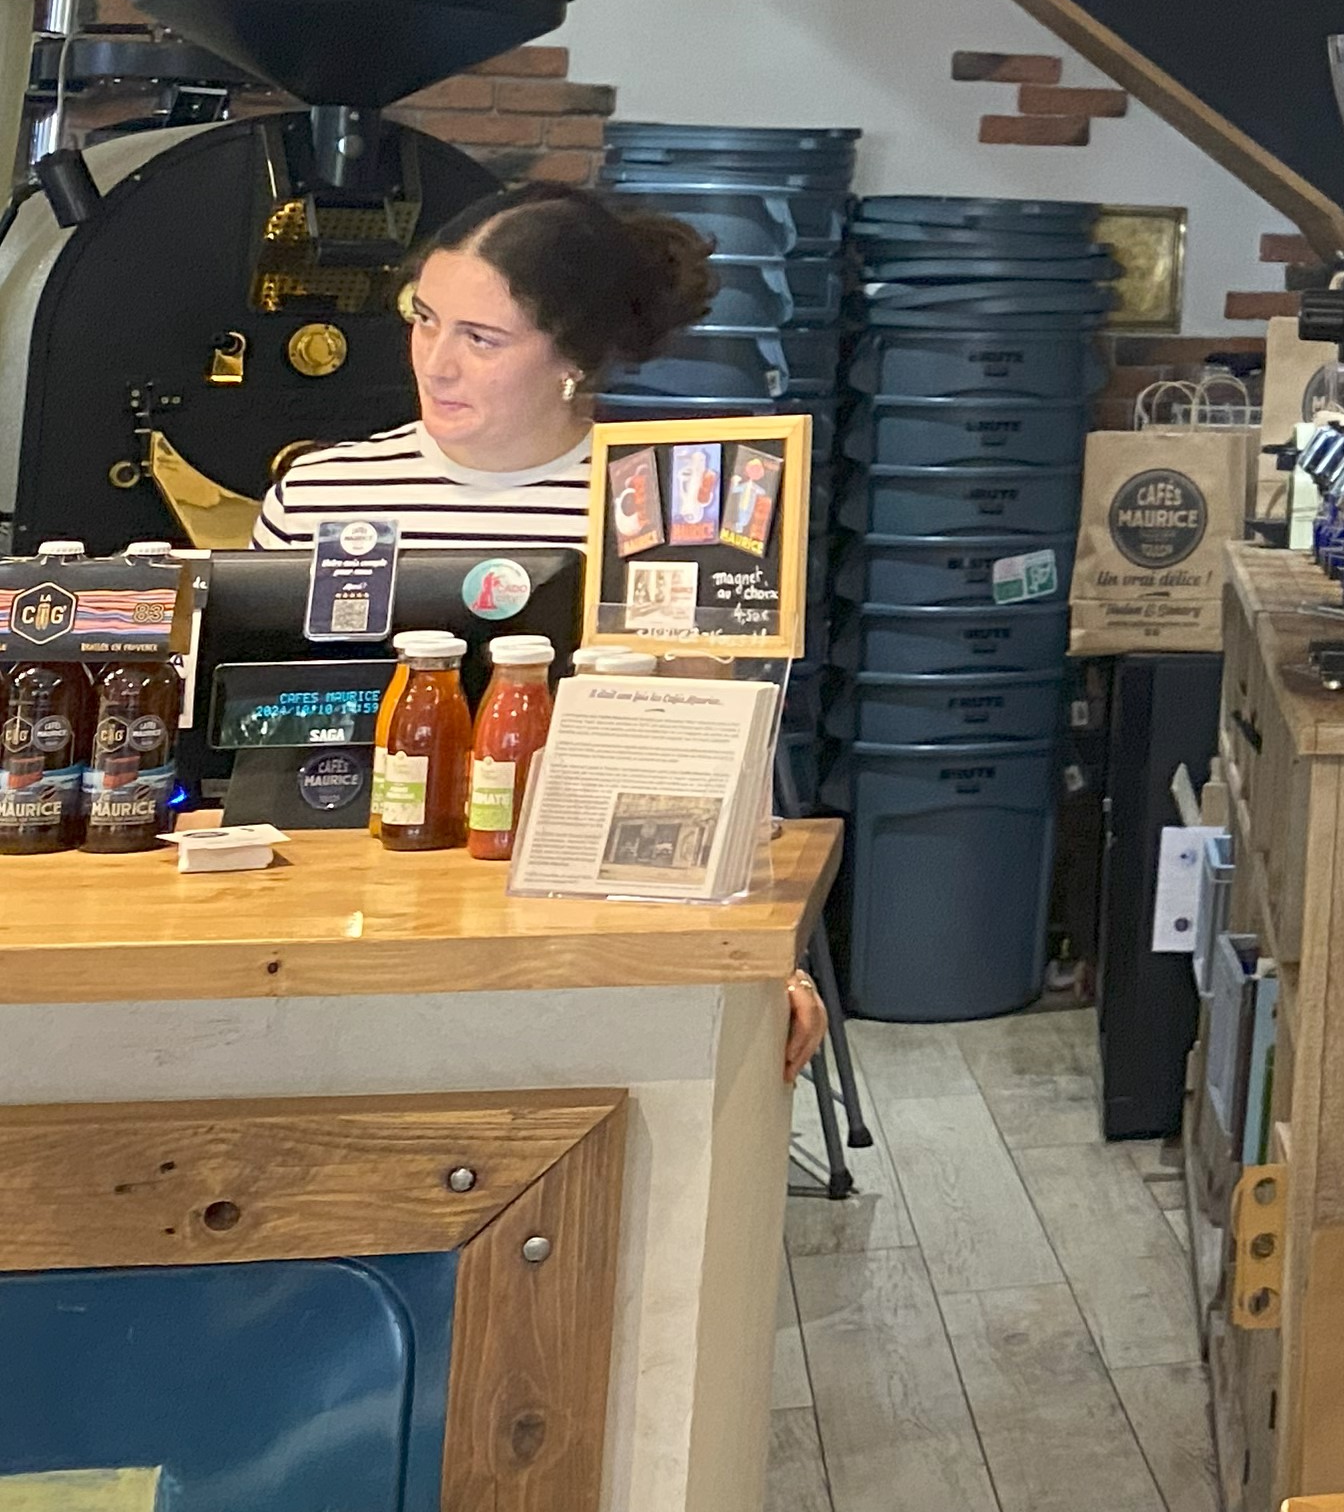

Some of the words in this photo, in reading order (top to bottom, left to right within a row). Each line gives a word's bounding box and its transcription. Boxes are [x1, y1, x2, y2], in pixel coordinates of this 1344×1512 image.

[1136, 480, 1183, 507] CAFÉS
[1118, 510, 1199, 528] MAURICE
[39, 594, 52, 602] LA
[133, 603, 165, 623] 83
[279, 692, 319, 705] CAFES
[325, 690, 381, 703] MAURICE
[255, 705, 333, 718] 2024/1010
[339, 702, 379, 715] 1:59
[309, 728, 345, 742] SAGA
[304, 774, 359, 787] MAURICE
[92, 799, 157, 817] MAURICE
